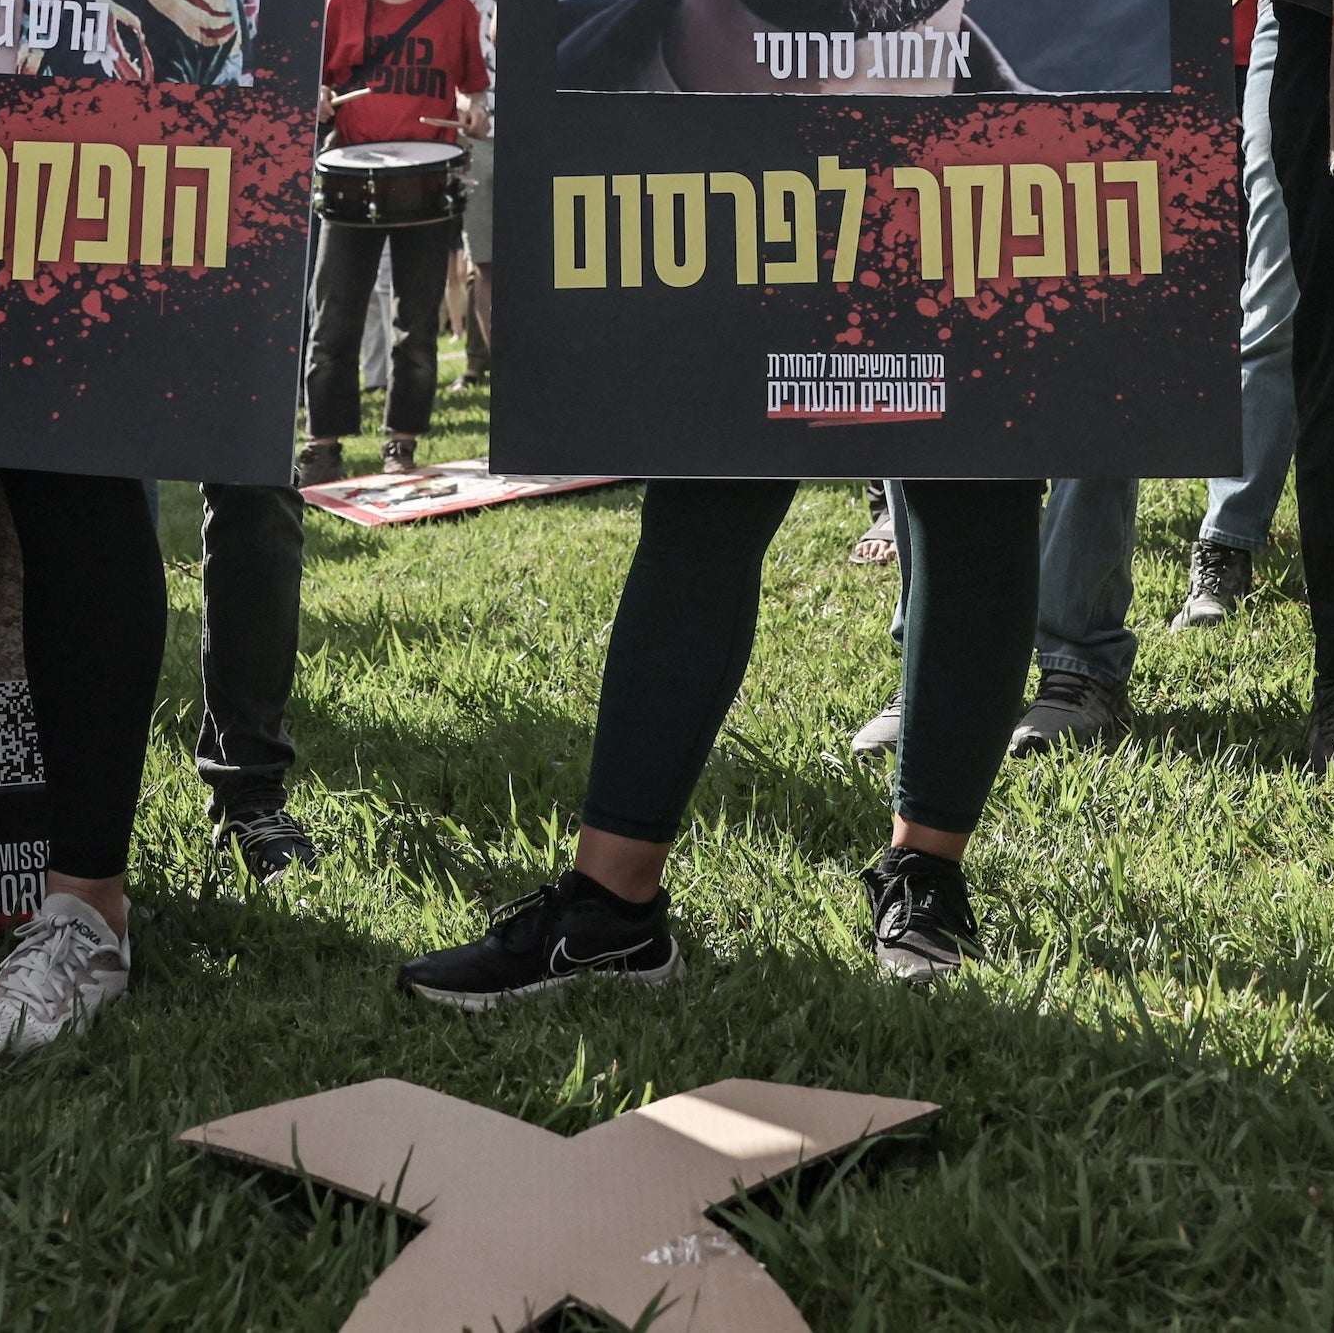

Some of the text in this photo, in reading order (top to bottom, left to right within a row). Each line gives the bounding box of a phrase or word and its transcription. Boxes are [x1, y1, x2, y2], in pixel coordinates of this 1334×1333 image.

[753, 25, 972, 80] אלמוג סרוסי
[553, 155, 1164, 299] הופקר לפרסום
[767, 352, 945, 379] מטה המשפחות להחזרת
[767, 380, 946, 413] החטופים והנעדרים
[69, 918, 101, 946] HOKA
